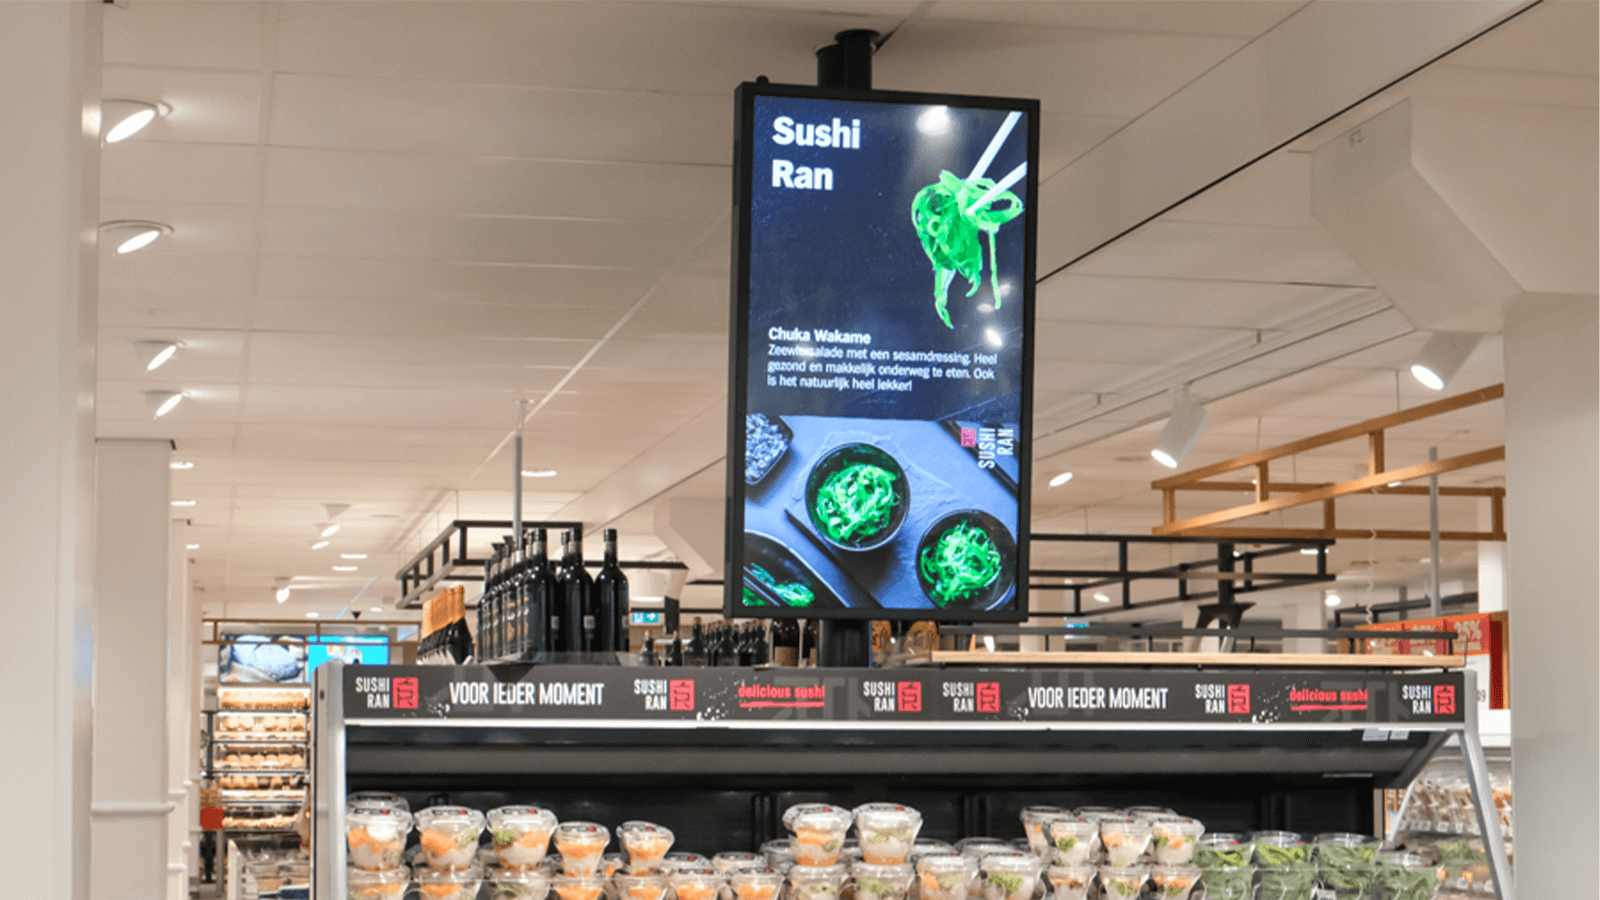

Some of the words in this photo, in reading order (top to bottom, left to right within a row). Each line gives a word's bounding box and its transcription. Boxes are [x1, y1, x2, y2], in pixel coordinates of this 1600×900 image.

[771, 116, 861, 149] Sushi
[771, 159, 834, 190] Ran
[768, 326, 811, 341] Chuka
[813, 328, 872, 344] Wakame
[846, 349, 868, 359] met
[870, 350, 890, 360] een
[973, 352, 998, 364] Heel
[767, 361, 807, 373] gezond
[809, 362, 823, 372] en
[825, 361, 876, 377] makkelijk
[877, 364, 930, 379] onderweg
[932, 366, 943, 377] te
[945, 367, 971, 378] eten.
[973, 367, 996, 379] Ook
[779, 374, 797, 387] het
[799, 376, 850, 391] natuurlijk
[852, 377, 875, 390] heel
[877, 378, 912, 391] lekker!
[978, 427, 996, 469] SUSHI
[996, 428, 1014, 455] RAN
[355, 677, 390, 692] SUSHI
[633, 679, 667, 694] SUSHI
[738, 683, 791, 699] delicious
[794, 684, 825, 699] sushi
[862, 681, 895, 696] SUSHI
[942, 682, 974, 697] SUSHI
[1195, 683, 1225, 699] SUSHI
[1402, 685, 1432, 699] SUSHI
[367, 693, 390, 709] RAN
[449, 682, 490, 704] VOOR
[493, 682, 535, 704] IEDER
[539, 682, 604, 705] MOMENT
[1028, 687, 1064, 708] VOOR
[1067, 687, 1105, 708] IEDER
[1109, 687, 1168, 709] MOMENT
[1289, 688, 1337, 702] delicious
[1340, 688, 1369, 702] sushi
[644, 695, 667, 710] RAN
[873, 697, 895, 712] RAN
[953, 698, 974, 712] RAN
[1205, 699, 1225, 714] RAN
[1412, 700, 1432, 714] RAN
